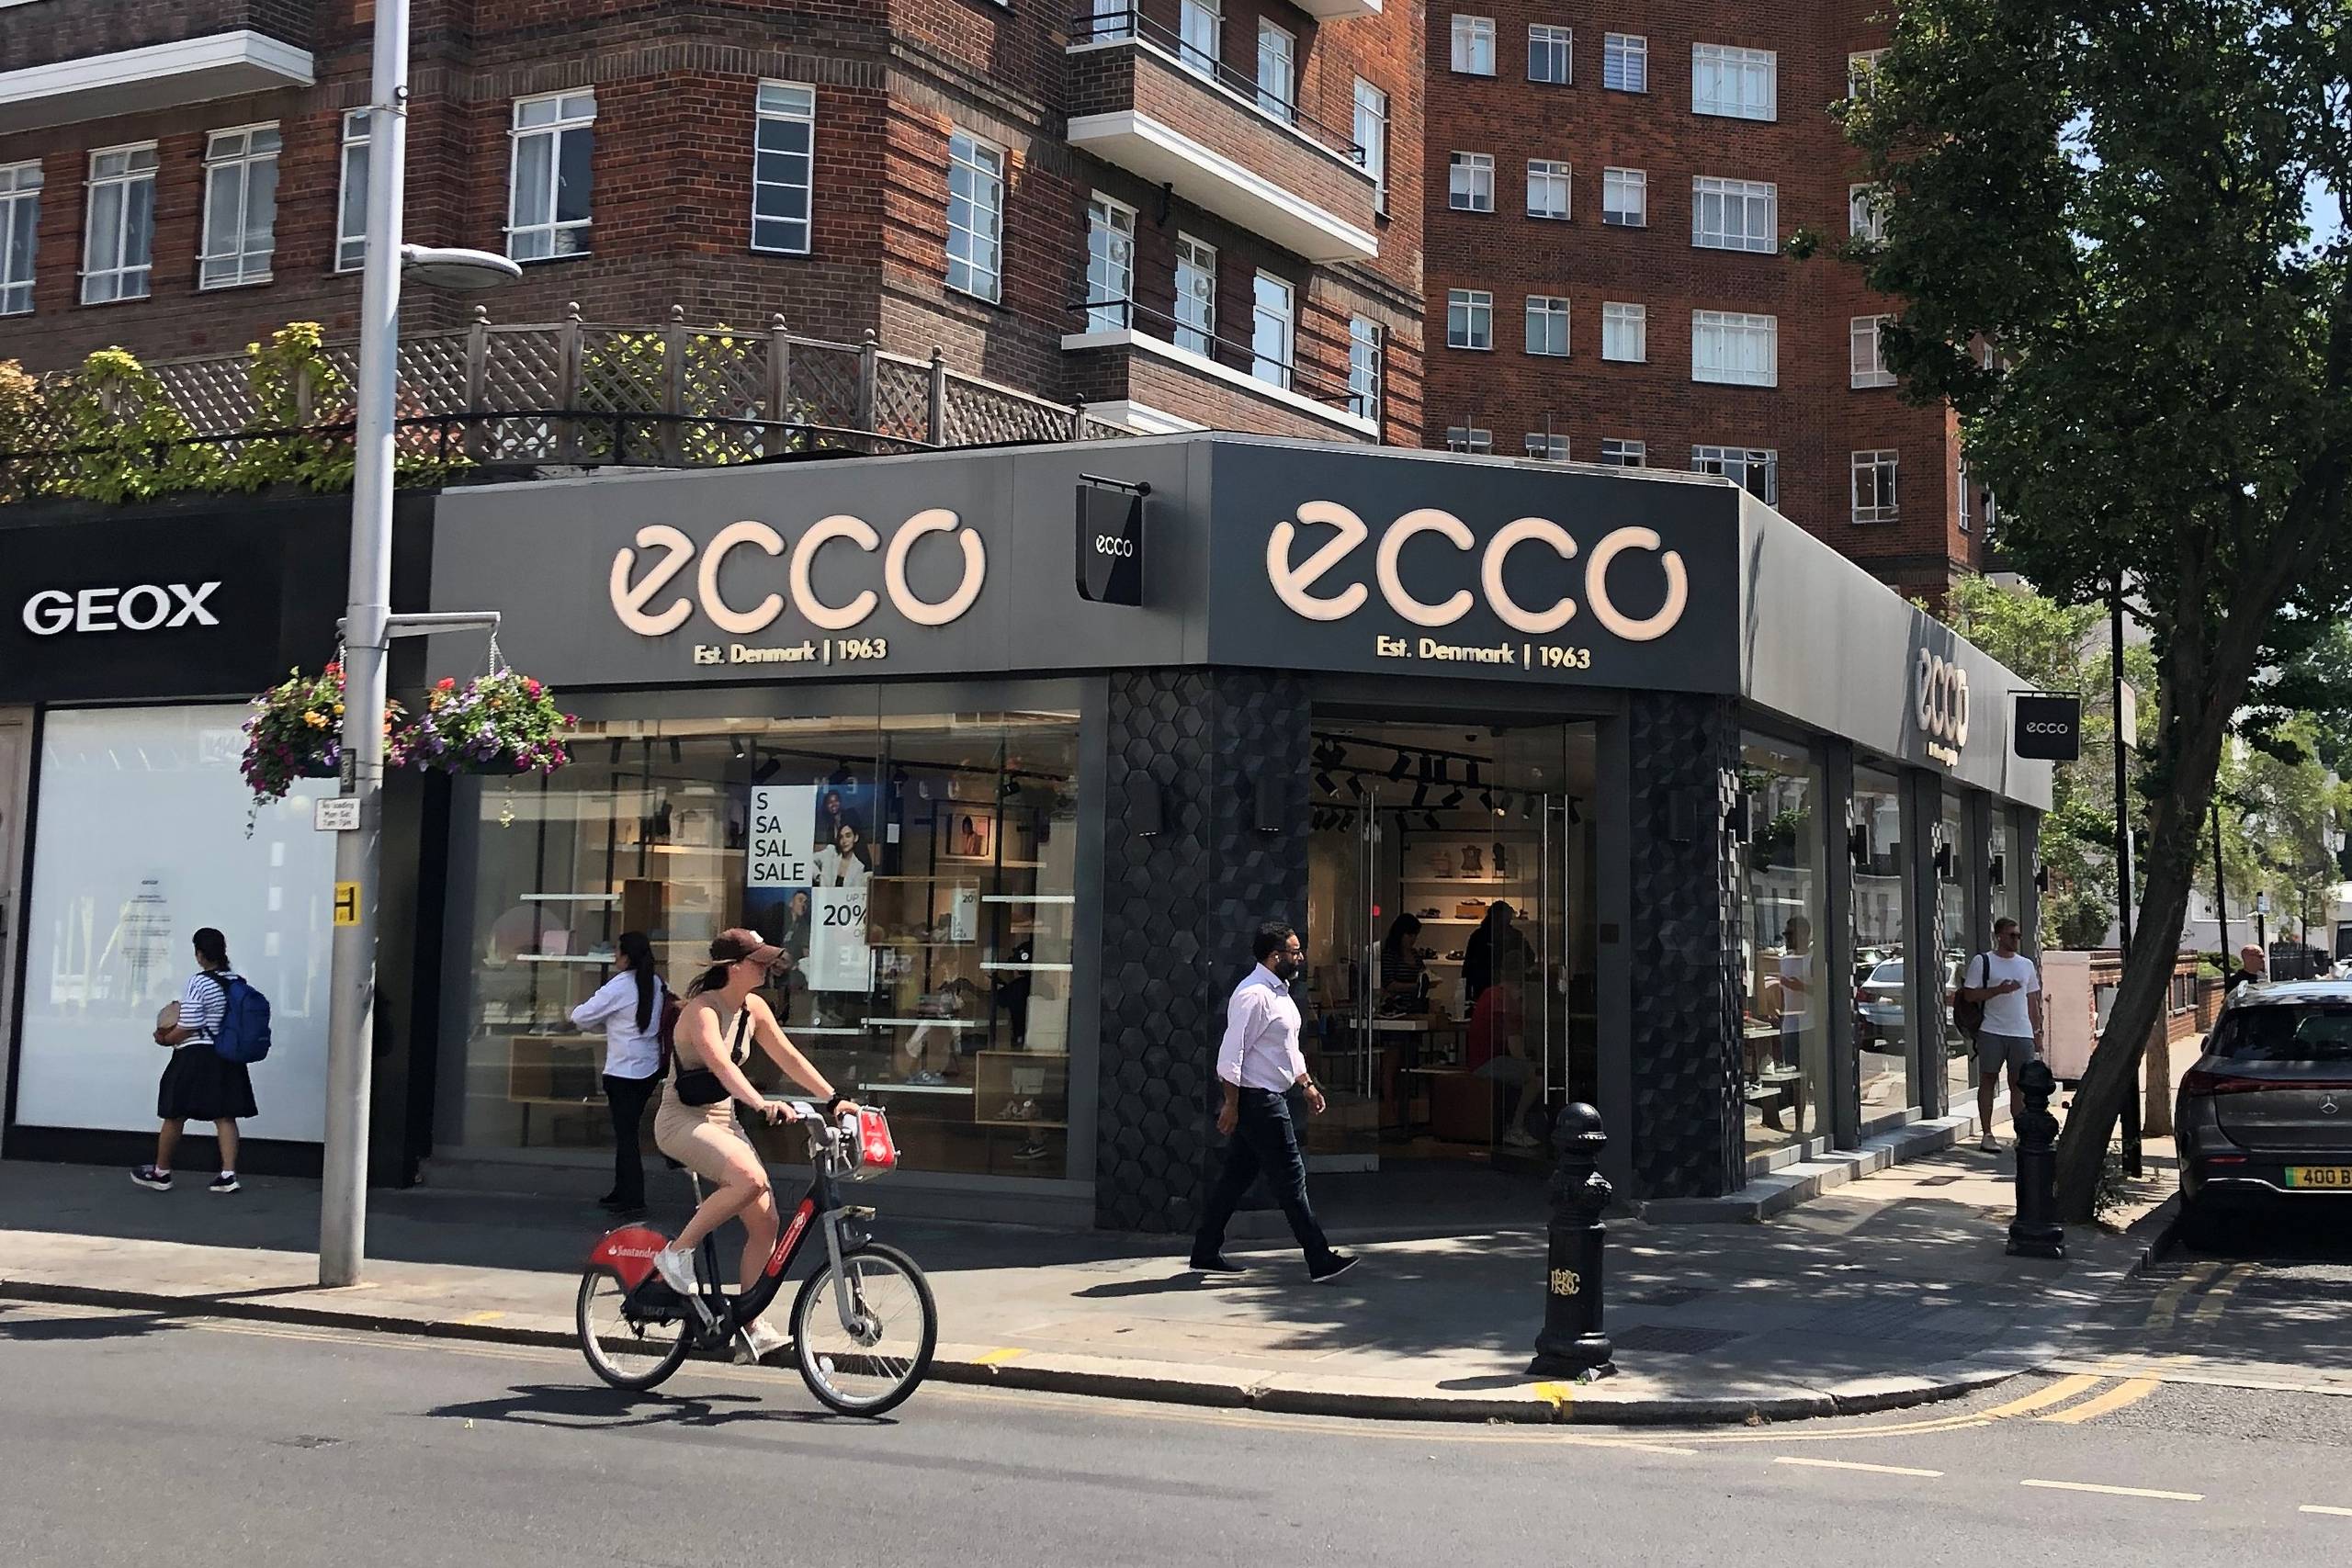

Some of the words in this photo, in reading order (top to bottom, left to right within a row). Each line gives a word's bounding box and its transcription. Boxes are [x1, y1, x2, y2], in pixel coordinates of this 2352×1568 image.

[1095, 534, 1134, 558] ecco
[610, 508, 987, 637] ecco
[1267, 501, 1689, 642] ecco
[22, 581, 222, 635] GEOX
[694, 644, 726, 665] Est.
[730, 640, 819, 664] Denmark
[837, 638, 888, 660] 1963
[1377, 636, 1412, 659] Est.
[1419, 638, 1516, 665] Denmark
[1539, 646, 1591, 670] 1963
[1916, 648, 1970, 748] ecco
[2026, 722, 2069, 735] ecco
[756, 792, 769, 811] S
[755, 815, 782, 834] SA
[754, 839, 793, 858] SAL
[753, 863, 805, 882] SALE
[846, 893, 860, 902] UP
[2303, 1169, 2336, 1184] 400
